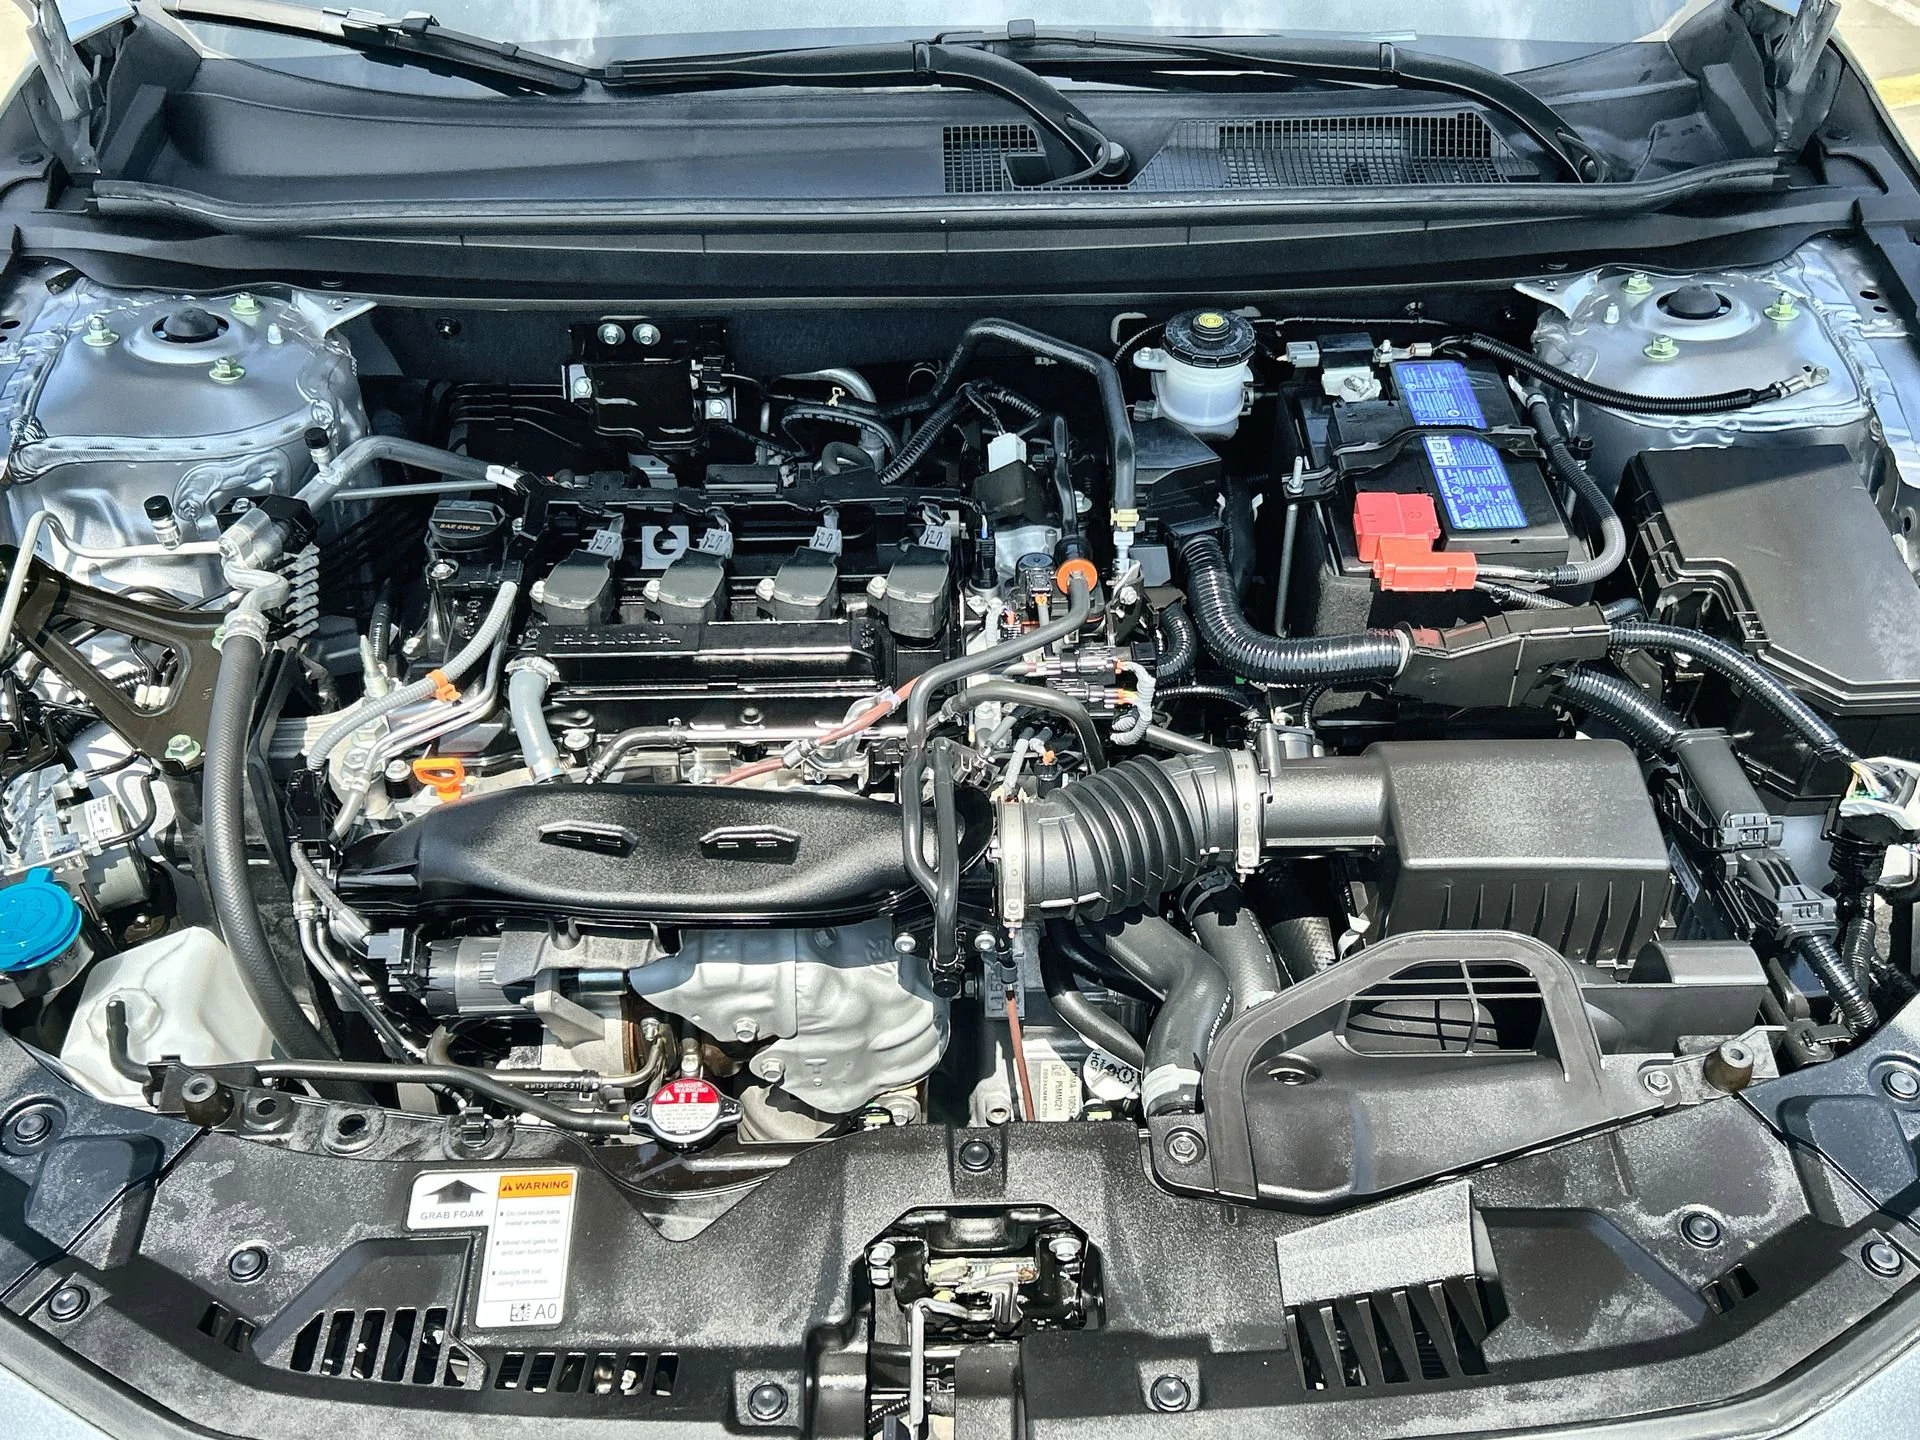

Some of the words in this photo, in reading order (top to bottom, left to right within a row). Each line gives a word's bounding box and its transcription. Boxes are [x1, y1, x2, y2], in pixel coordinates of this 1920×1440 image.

[515, 1180, 569, 1191] WARNING
[420, 1211, 450, 1220] GRAB
[453, 1209, 484, 1219] FOAM
[534, 1302, 557, 1320] A0
